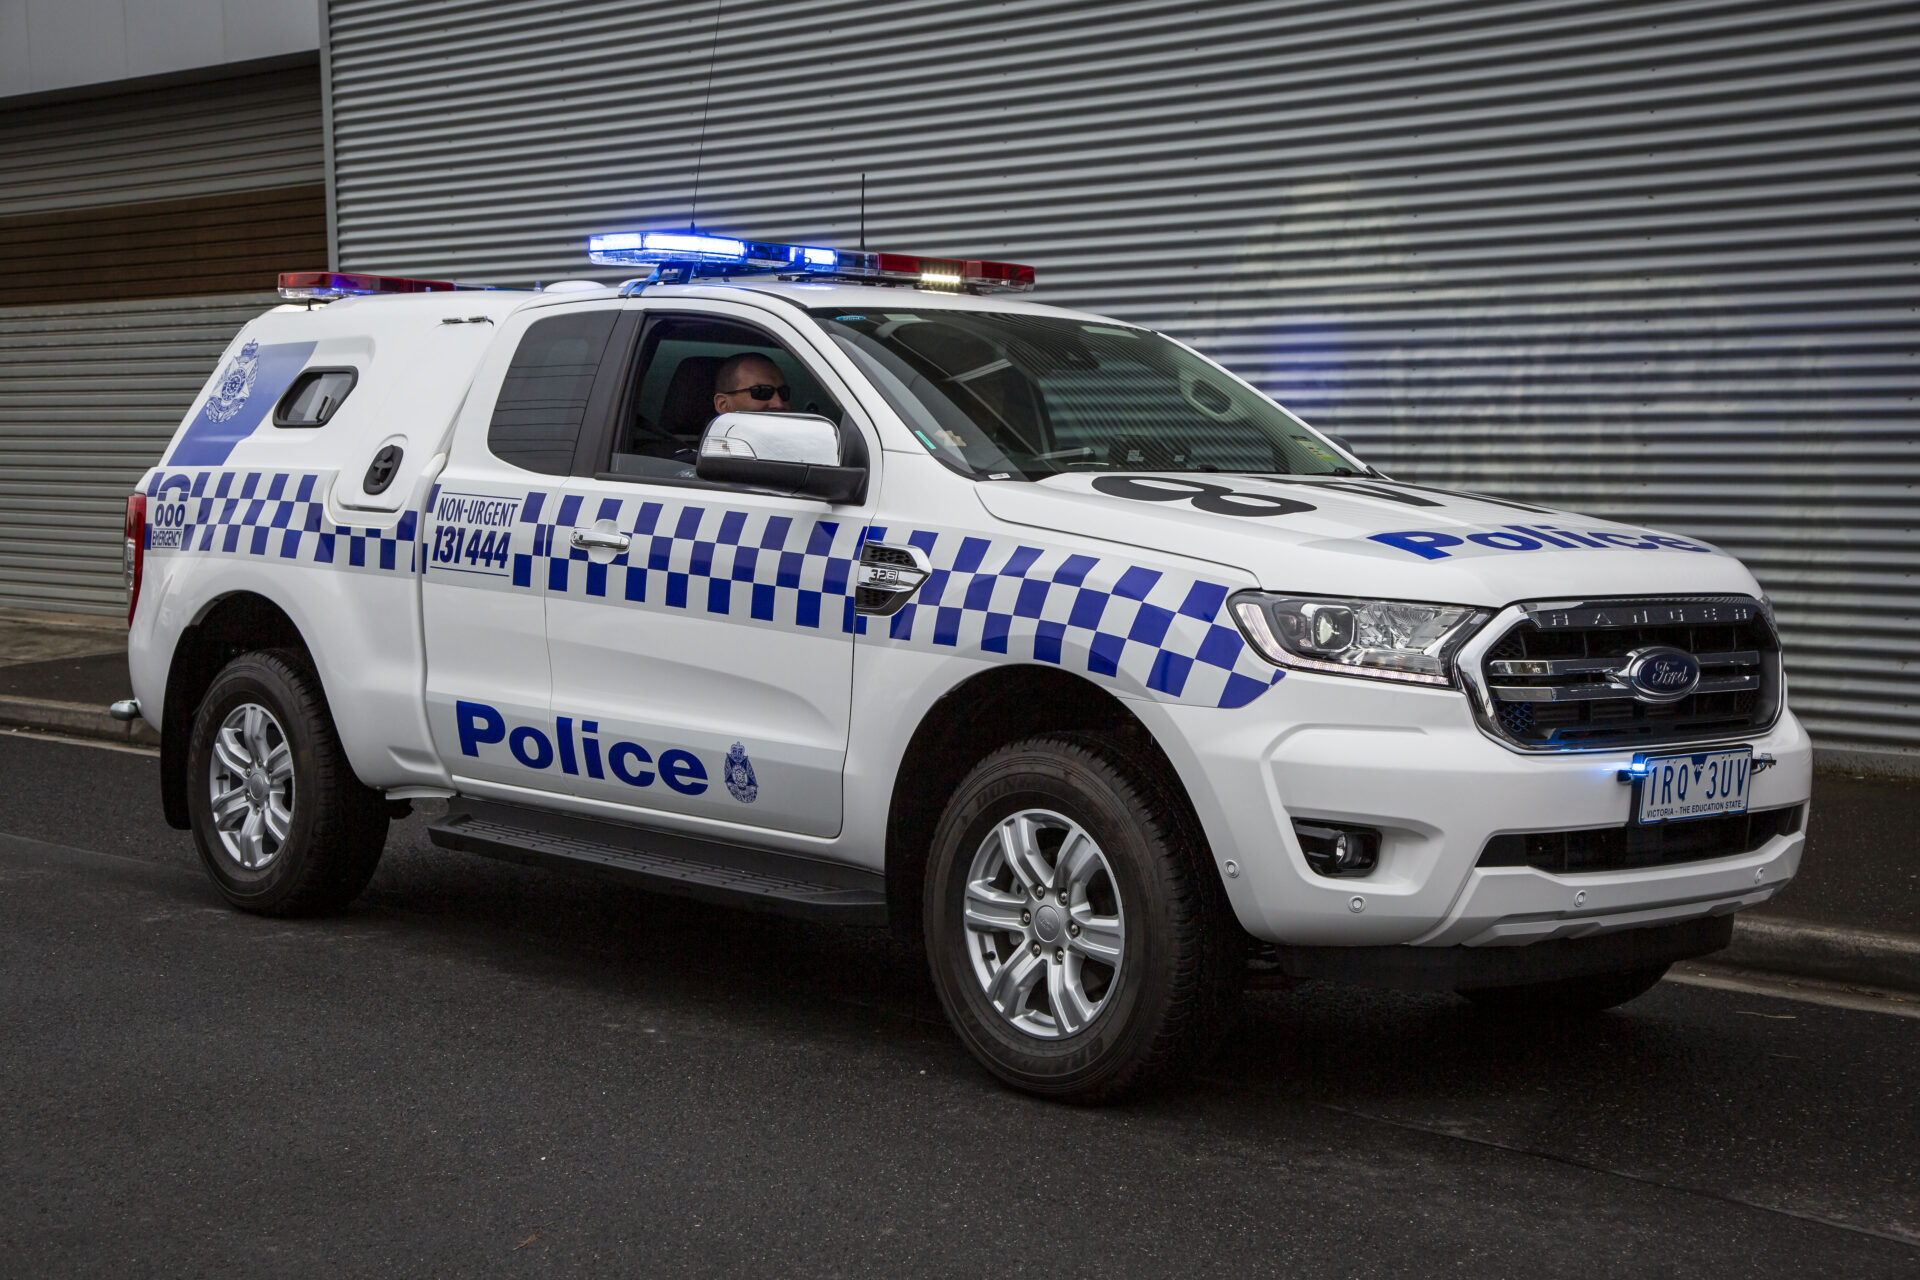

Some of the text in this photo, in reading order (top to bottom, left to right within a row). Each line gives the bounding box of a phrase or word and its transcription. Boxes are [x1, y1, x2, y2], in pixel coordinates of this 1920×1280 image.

[155, 504, 186, 527] 000
[437, 498, 518, 527] NON-URGENT
[152, 530, 182, 546] EMERGENCY
[432, 525, 511, 569] 131 444
[1366, 525, 1712, 560] Police
[1652, 660, 1688, 685] Ford
[456, 700, 708, 795] Police
[1650, 758, 1748, 806] 1RQ 3UV
[1646, 808, 1674, 818] VICTORIA
[1680, 806, 1691, 814] THE
[1692, 802, 1724, 813] EDUCATION
[1725, 800, 1742, 809] STATE
